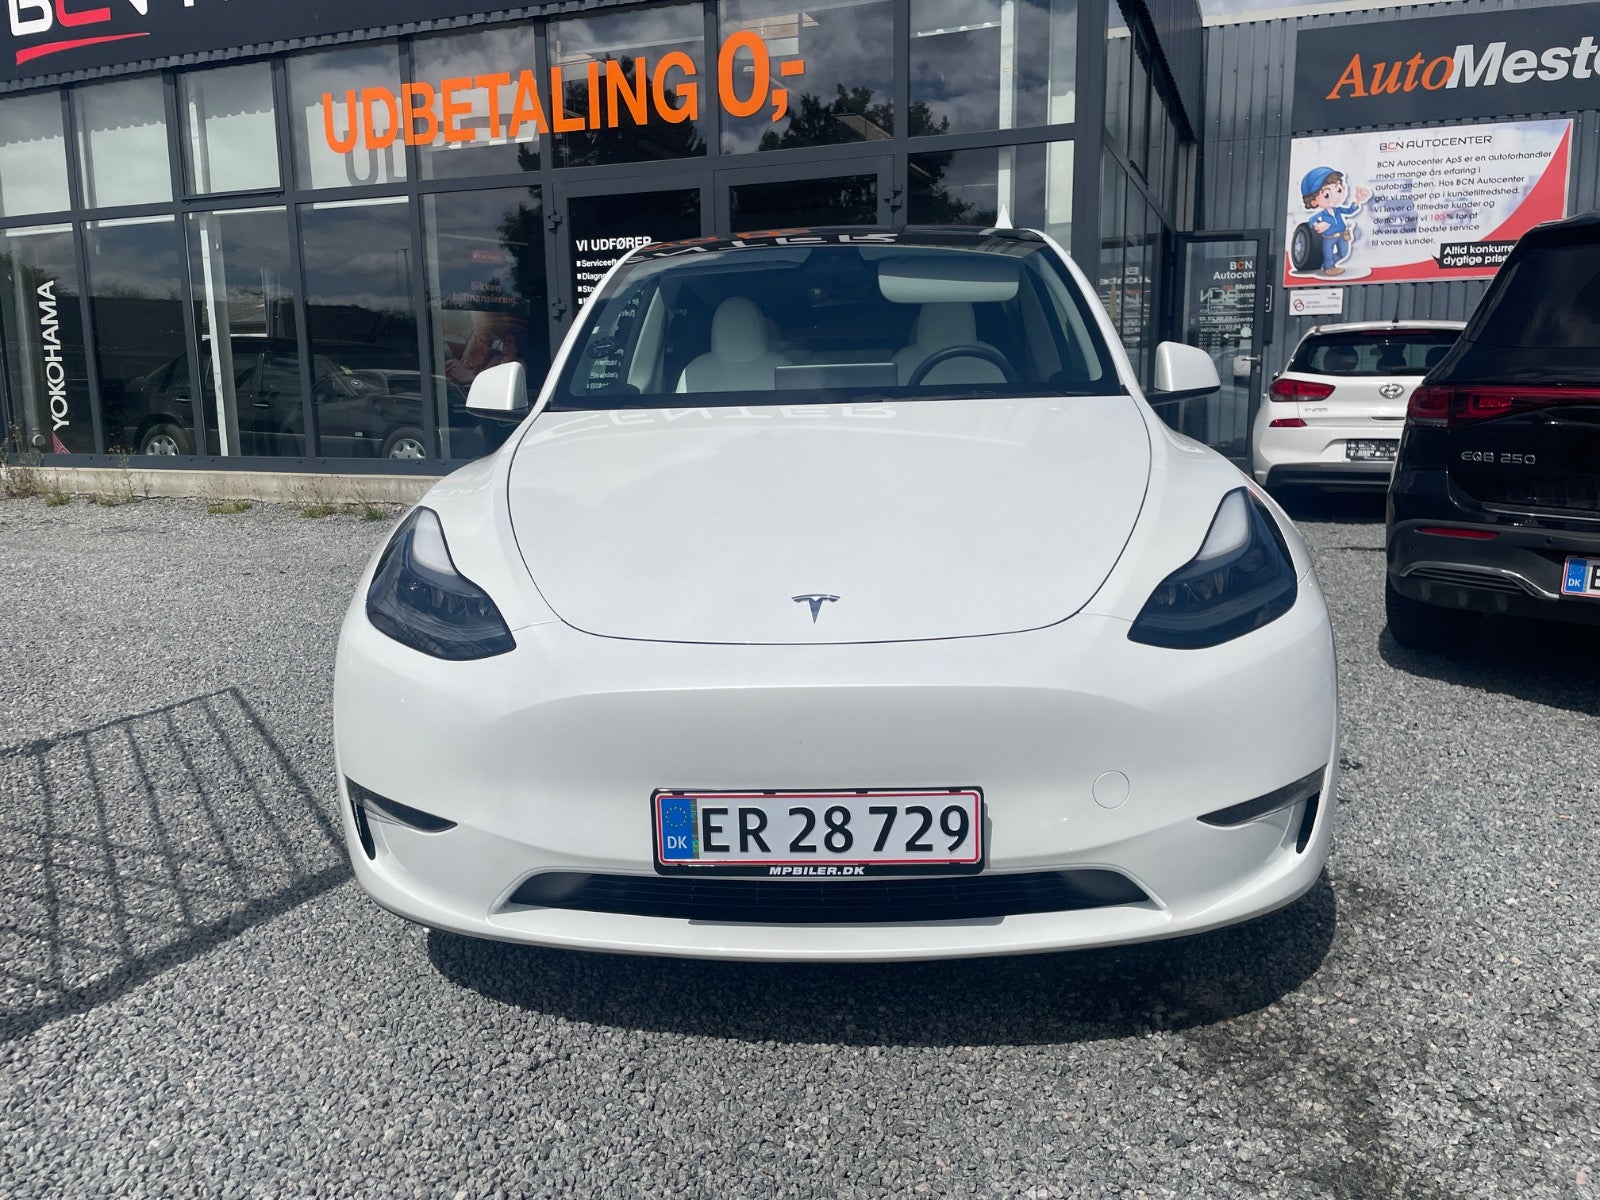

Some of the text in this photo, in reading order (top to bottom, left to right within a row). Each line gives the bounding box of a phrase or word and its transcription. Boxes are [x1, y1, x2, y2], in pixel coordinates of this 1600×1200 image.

[1325, 36, 1600, 100] AutoMest
[321, 52, 698, 154] UDBETALING
[1379, 135, 1493, 151] BCN AUTOCENTER
[1377, 160, 1395, 168] BCN
[1397, 157, 1443, 167] Autocenter
[1445, 155, 1462, 165] ApS
[1488, 151, 1552, 161] autoforhandler
[1376, 172, 1395, 180] med
[1397, 170, 1427, 179] mange
[1429, 168, 1442, 176] års
[1443, 166, 1477, 175] erfaring
[1438, 179, 1454, 187] Hos
[1456, 177, 1475, 186] BCN
[1477, 175, 1525, 185] Autocenter
[1400, 192, 1427, 202] meget
[1452, 201, 1481, 209] kunder
[1419, 225, 1447, 234] bedste
[1449, 223, 1480, 232] service
[576, 239, 588, 252] VI
[1444, 245, 1467, 255] Altid
[1443, 255, 1483, 267] dygtige
[1213, 270, 1257, 281] Autocen
[37, 279, 70, 432] YOKOHAMA
[1460, 451, 1537, 465] EQB 250
[1568, 578, 1581, 587] DK
[702, 806, 772, 853] ER
[788, 805, 854, 853] 28
[868, 804, 970, 853] 729
[667, 835, 688, 850] DK
[768, 865, 866, 876] MPBILER.DK
